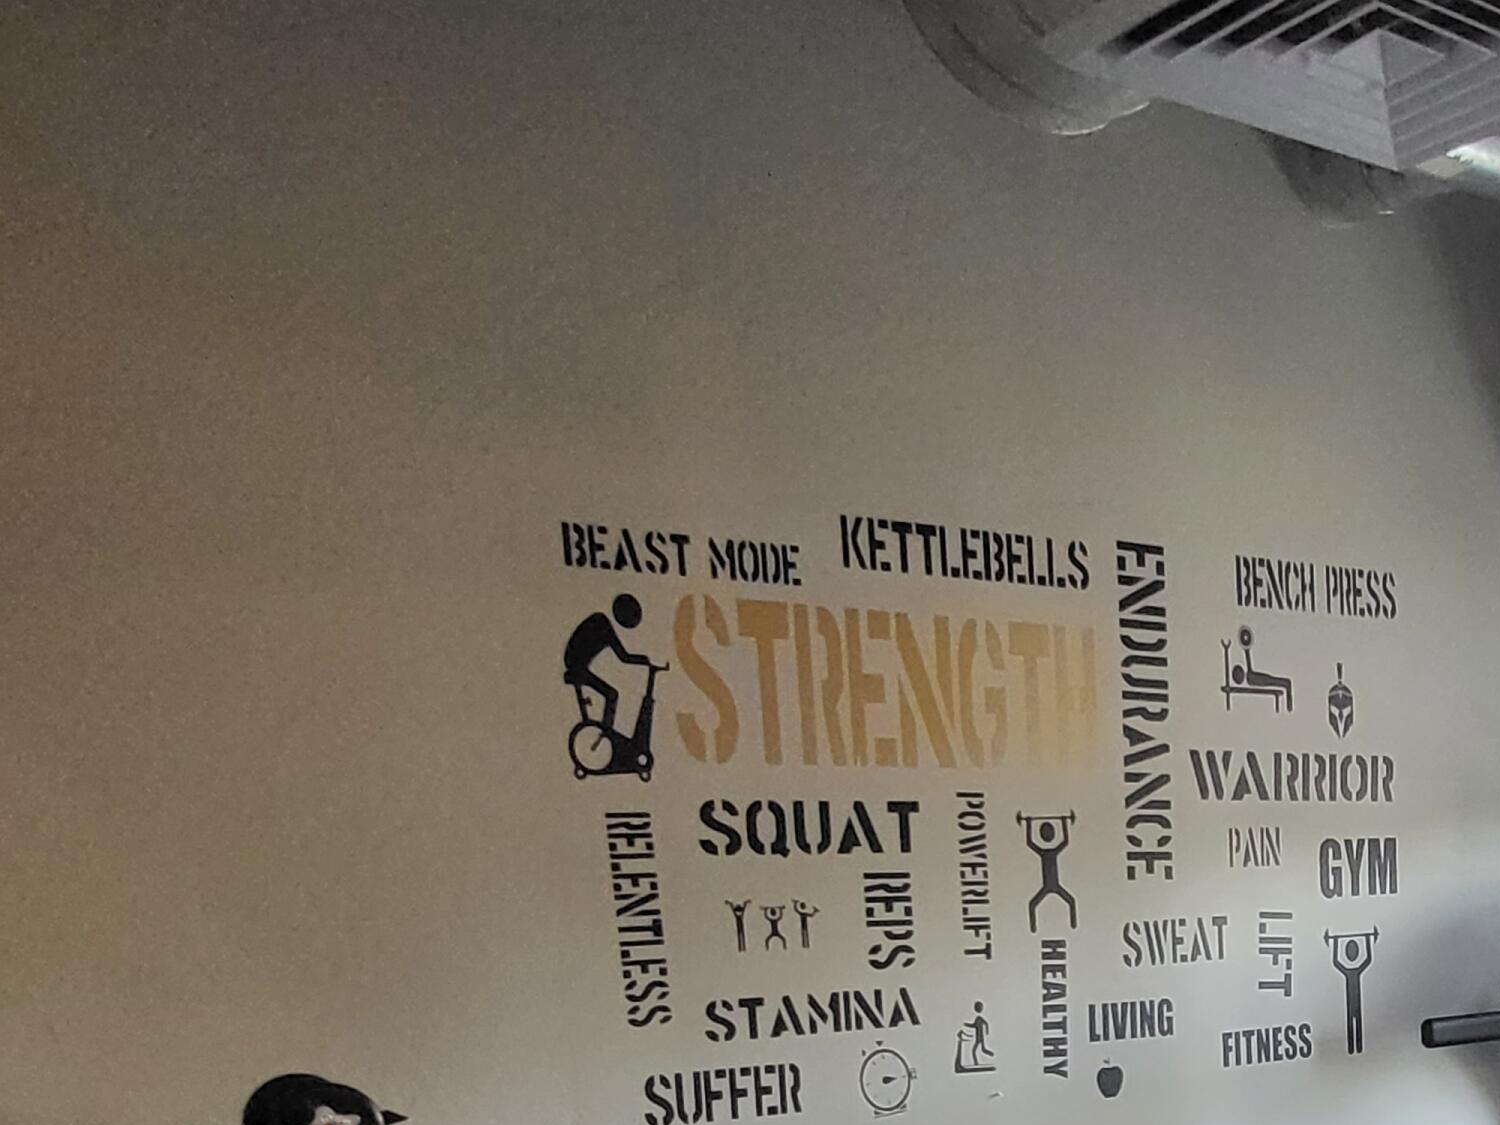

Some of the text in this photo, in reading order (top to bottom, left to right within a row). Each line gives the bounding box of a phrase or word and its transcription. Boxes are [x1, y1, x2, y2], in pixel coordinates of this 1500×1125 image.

[561, 522, 801, 585] BEAST MODE
[840, 515, 1089, 589] KETTLEBELLS
[1236, 555, 1396, 619] BENCH PRESS
[1116, 540, 1172, 880] ENDURANCE
[1189, 749, 1393, 801] WARRIOR
[699, 799, 919, 858] SQUAT
[1229, 827, 1280, 867] PAIN
[956, 792, 991, 959] POWERLIFT
[1319, 838, 1397, 898] GYM
[605, 812, 672, 1027] RELENTLESS
[863, 873, 915, 969] REPS
[1123, 916, 1227, 967] SWEAT
[1258, 912, 1292, 997] LIFT
[705, 988, 920, 1042] STAMINA
[1041, 940, 1068, 1078] HEALTHY
[1089, 999, 1173, 1042] LIVING
[1222, 1024, 1312, 1067] FITNESS
